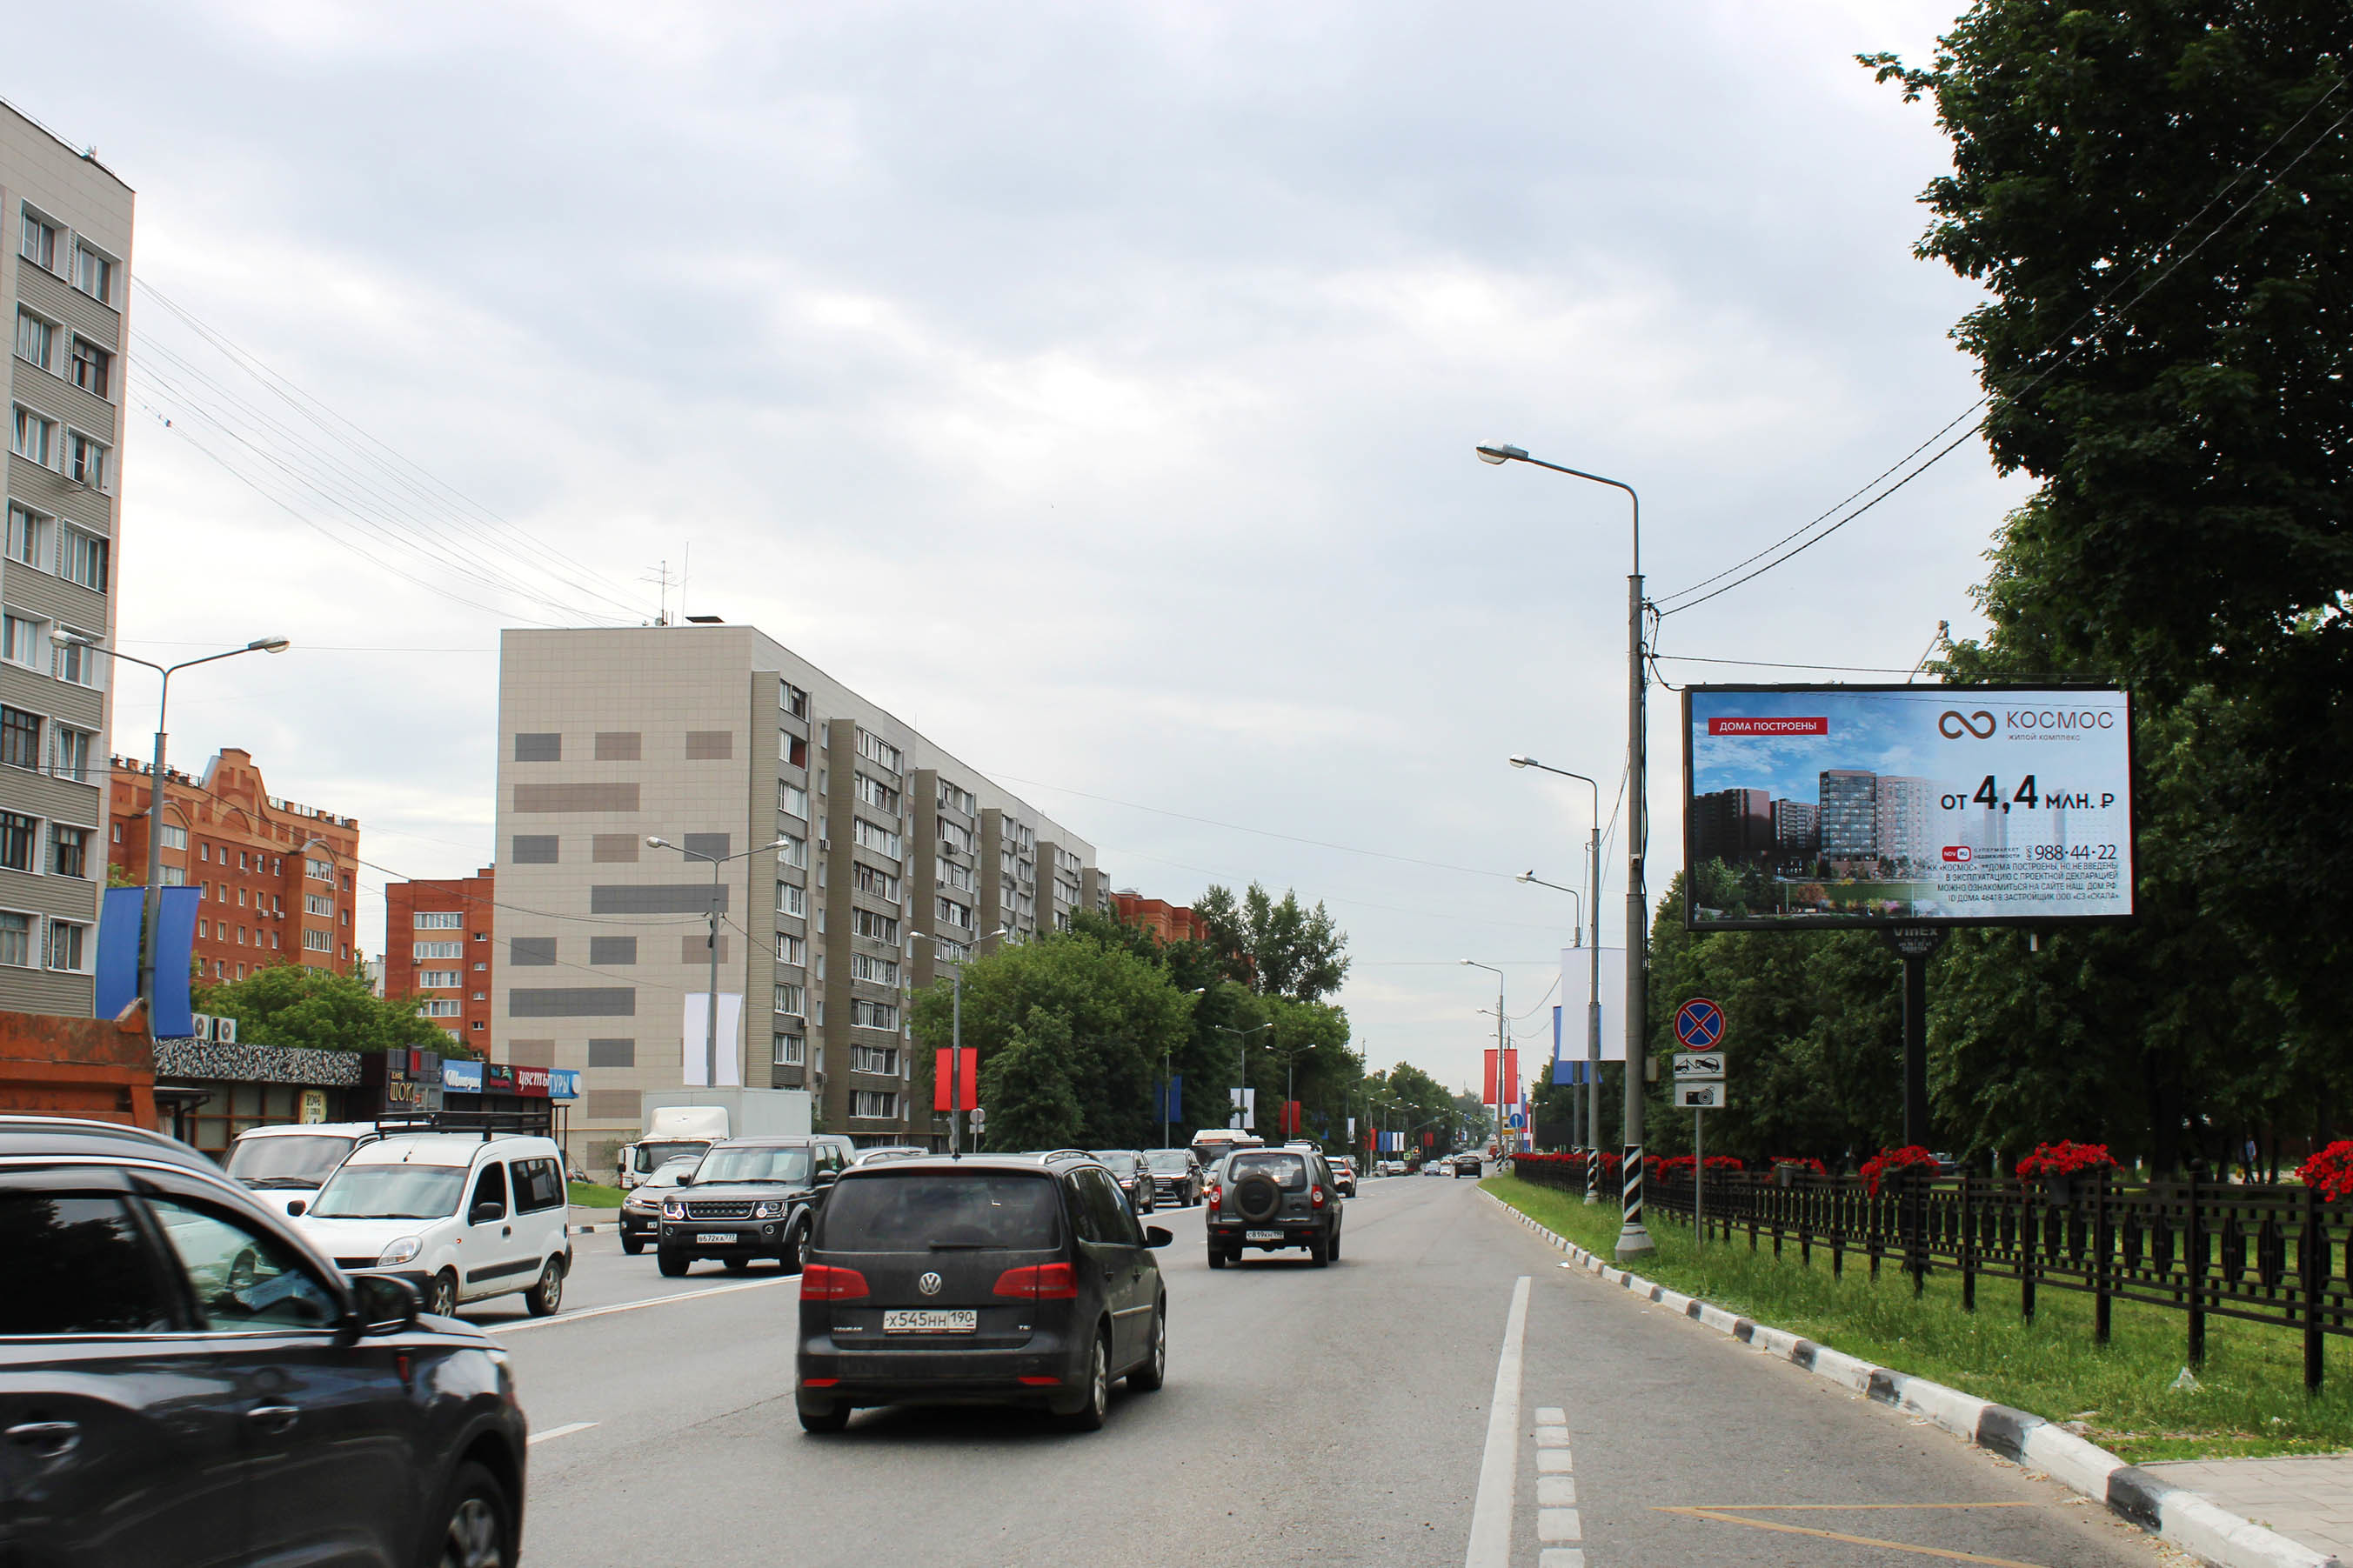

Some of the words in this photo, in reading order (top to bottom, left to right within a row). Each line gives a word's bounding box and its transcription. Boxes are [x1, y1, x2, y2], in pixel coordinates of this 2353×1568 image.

[1719, 721, 1752, 732] ДОМА
[1753, 721, 1817, 731] ПОСТРОЕНЫ
[2006, 711, 2115, 730] КОСМОС
[2007, 732, 2036, 741] жилой
[1940, 794, 1968, 810] ОТ
[1972, 774, 2039, 815] 4,4
[2045, 793, 2095, 810] МЛН.
[2060, 862, 2070, 871] НО
[2072, 862, 2082, 871] НЕ
[2083, 861, 2118, 871] ВВЕДЕНЫ
[1952, 872, 2012, 882] ЭКСПЛУАТАЦИЮ
[2020, 871, 2063, 880] ПРОЕКТНОЙ
[2065, 870, 2118, 881] ДЕКЛАРАЦИЕЙ
[1937, 883, 1967, 891] МОЖНО
[1968, 883, 2028, 891] ОЗНАКОМИТЬСЯ
[2029, 882, 2039, 891] НА
[2041, 881, 2065, 891] САЙТЕ
[1957, 893, 1980, 903] ДОМА
[2003, 891, 2054, 901] ЗАСТРОЙЩИК
[518, 1070, 550, 1091] цветы
